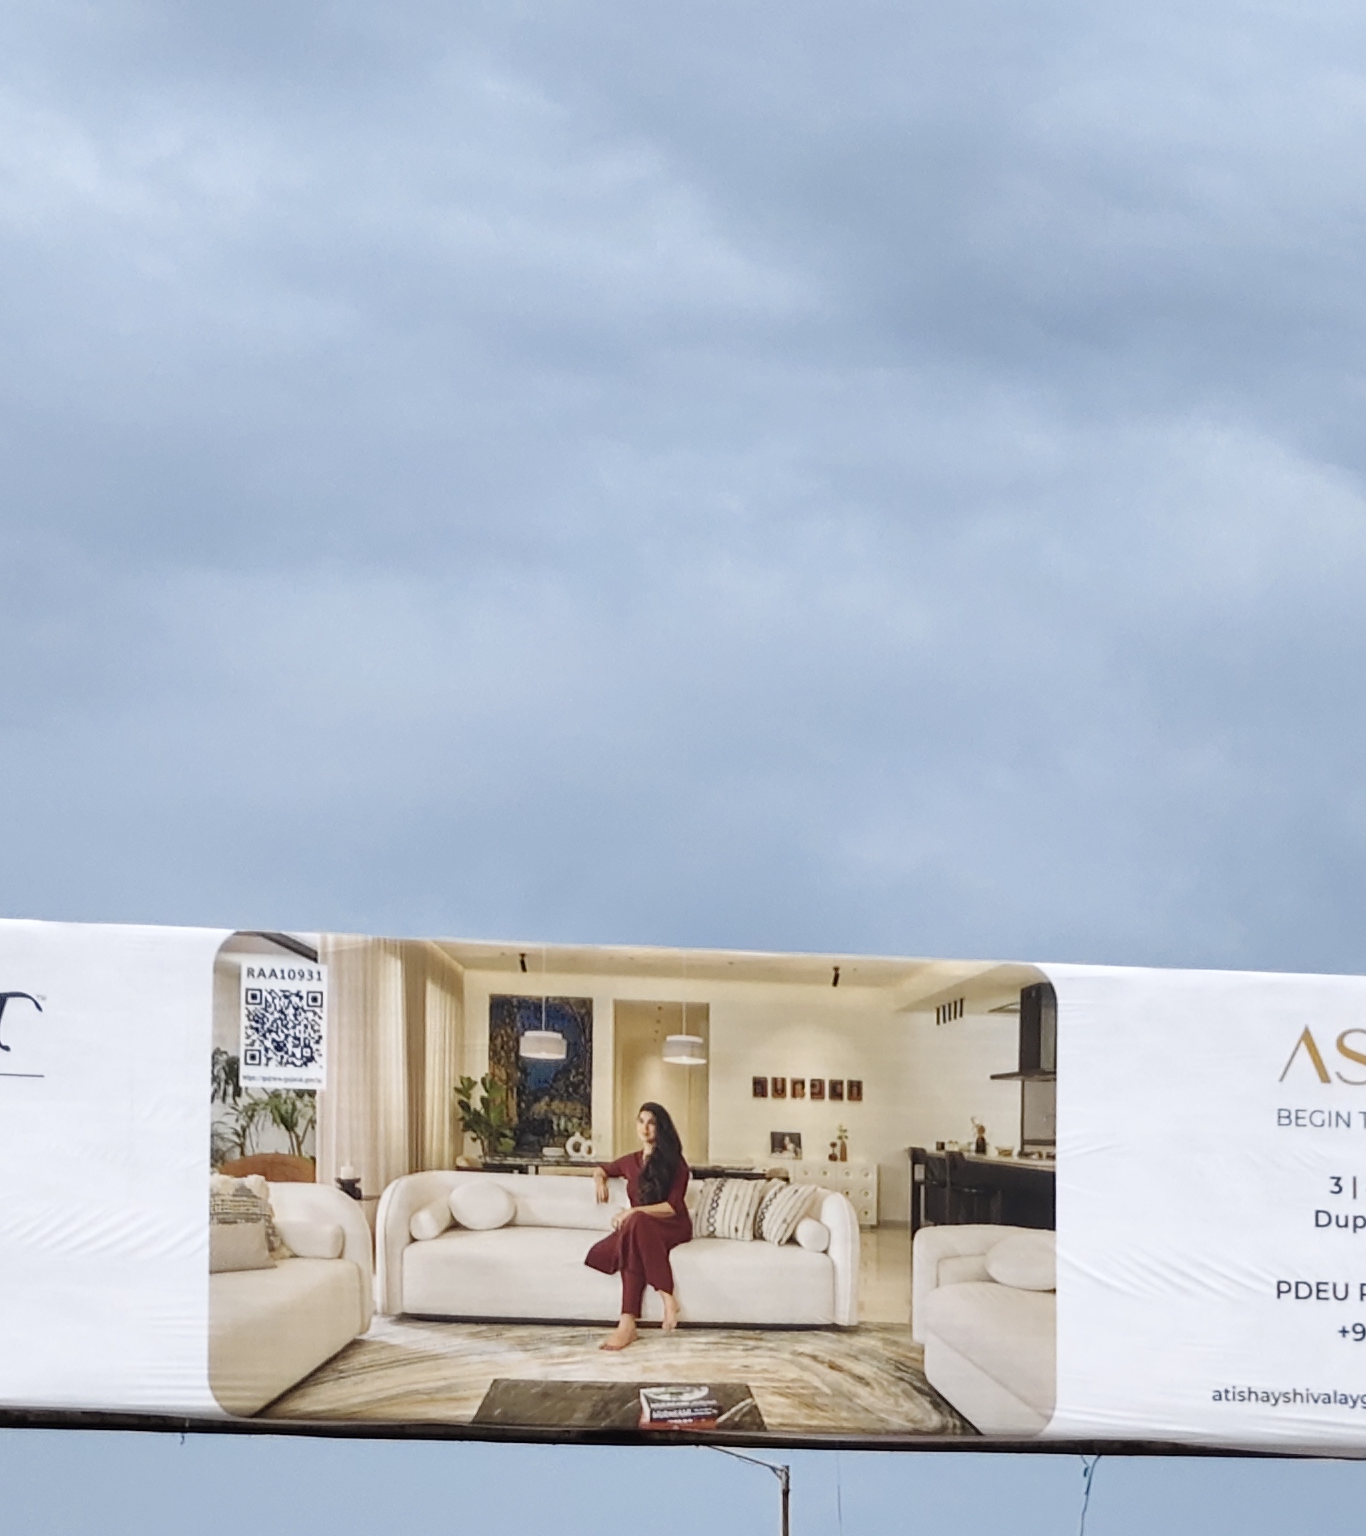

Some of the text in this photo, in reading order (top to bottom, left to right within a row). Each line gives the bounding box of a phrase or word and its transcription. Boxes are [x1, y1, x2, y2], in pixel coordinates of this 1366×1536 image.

[246, 966, 323, 982] RAA10931
[1276, 1107, 1352, 1129] BEGIN
[1328, 1175, 1344, 1196] 3
[1275, 1280, 1350, 1301] PDEU
